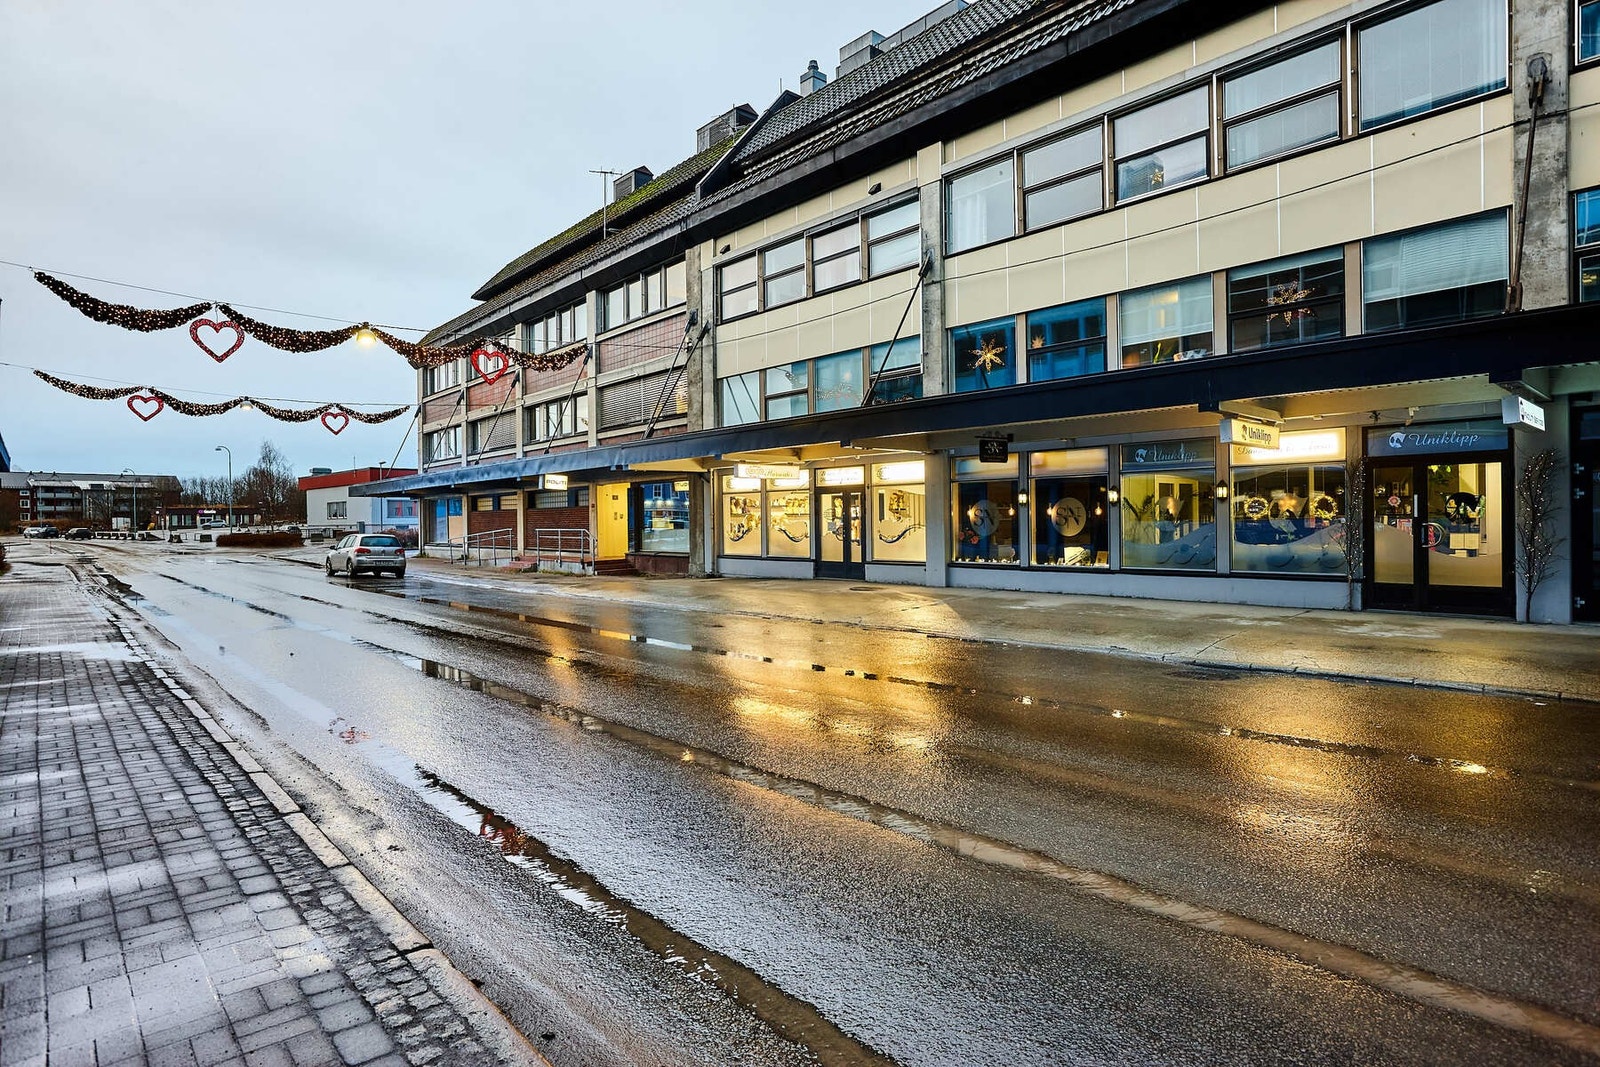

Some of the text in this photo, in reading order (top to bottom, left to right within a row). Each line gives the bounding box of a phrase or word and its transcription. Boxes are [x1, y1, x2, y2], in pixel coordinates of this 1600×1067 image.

[1248, 426, 1272, 445] Uniklipp
[1409, 431, 1480, 447] Uniklipp
[1149, 445, 1197, 462] Uniklipp
